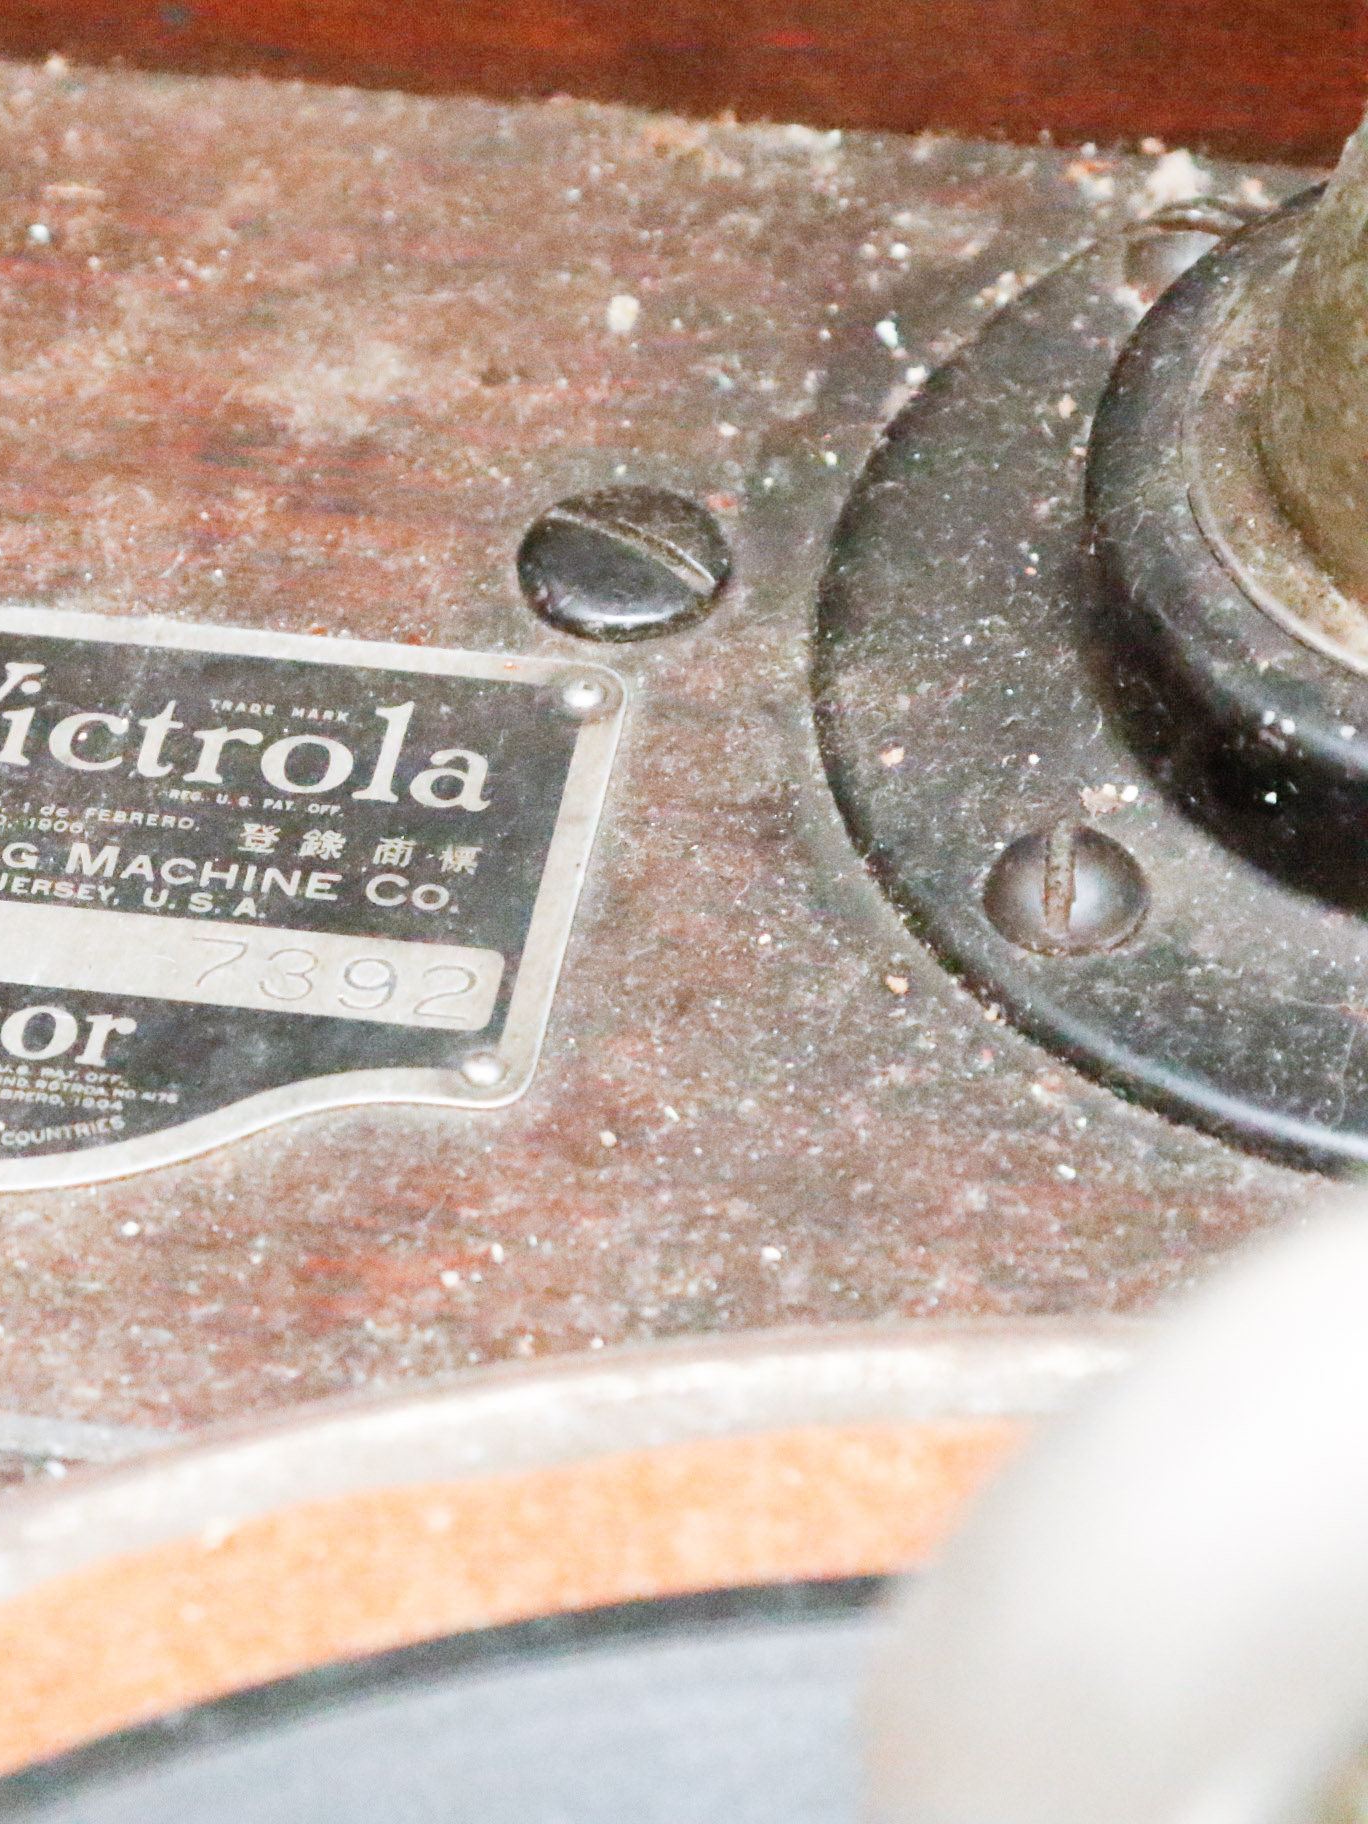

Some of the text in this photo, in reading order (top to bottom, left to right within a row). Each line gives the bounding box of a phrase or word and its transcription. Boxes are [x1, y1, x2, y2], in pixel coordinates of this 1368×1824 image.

[209, 699, 350, 723] TRADE MARK
[40, 803, 70, 818] de
[85, 807, 201, 832] FEBRERO,
[65, 842, 343, 901] MACHINE
[191, 936, 479, 1022] 7392
[1, 1114, 127, 1147] COUNTRIES
